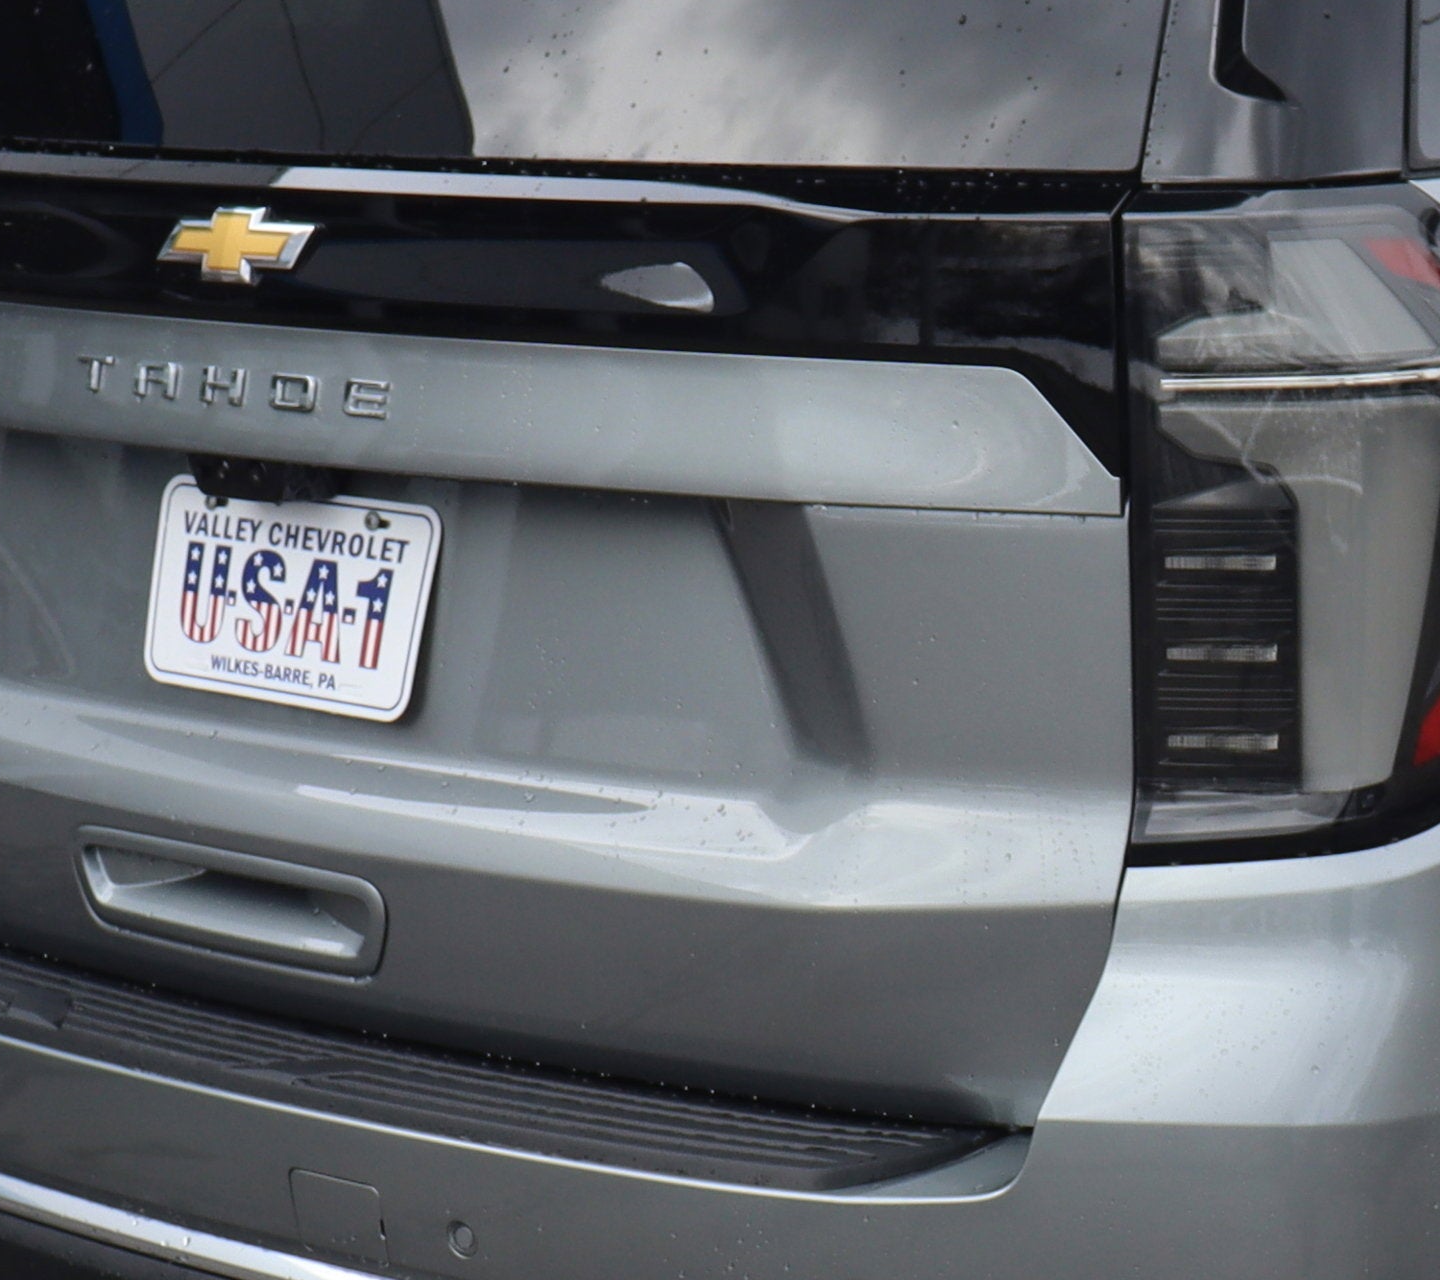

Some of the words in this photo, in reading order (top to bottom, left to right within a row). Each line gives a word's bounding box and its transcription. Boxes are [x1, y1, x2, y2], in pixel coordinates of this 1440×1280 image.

[78, 355, 393, 419] TAHOE
[183, 510, 262, 543] VALLEY
[268, 521, 411, 564] CHEVROLET
[317, 672, 337, 691] PA
